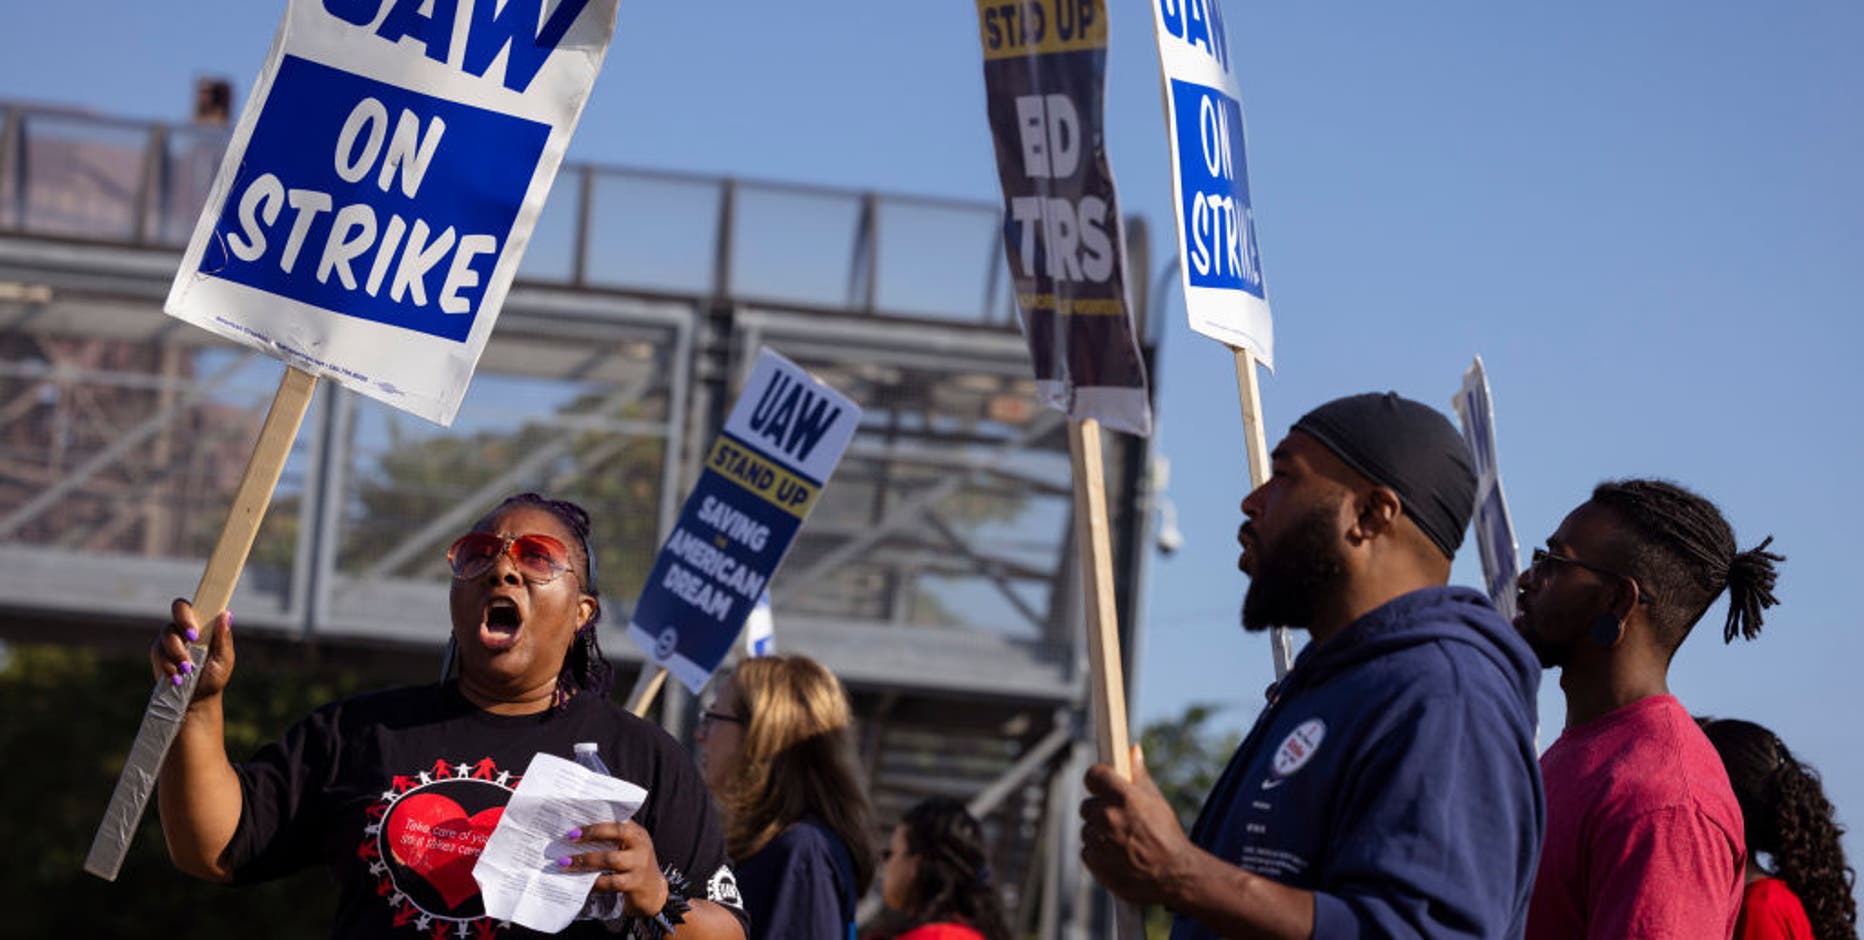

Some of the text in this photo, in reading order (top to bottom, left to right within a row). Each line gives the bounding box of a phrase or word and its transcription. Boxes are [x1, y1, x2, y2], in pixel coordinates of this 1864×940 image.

[1055, 0, 1095, 42] UP
[335, 97, 446, 199] ON
[1200, 94, 1233, 181] ON
[227, 173, 496, 314] STRIKE
[749, 369, 842, 463] UAW
[713, 444, 809, 507] STAND UP
[697, 495, 770, 554] SAVING
[662, 563, 735, 621] DREAM
[667, 528, 765, 601] AMERICAN
[405, 818, 431, 834] Take
[432, 827, 456, 839] care
